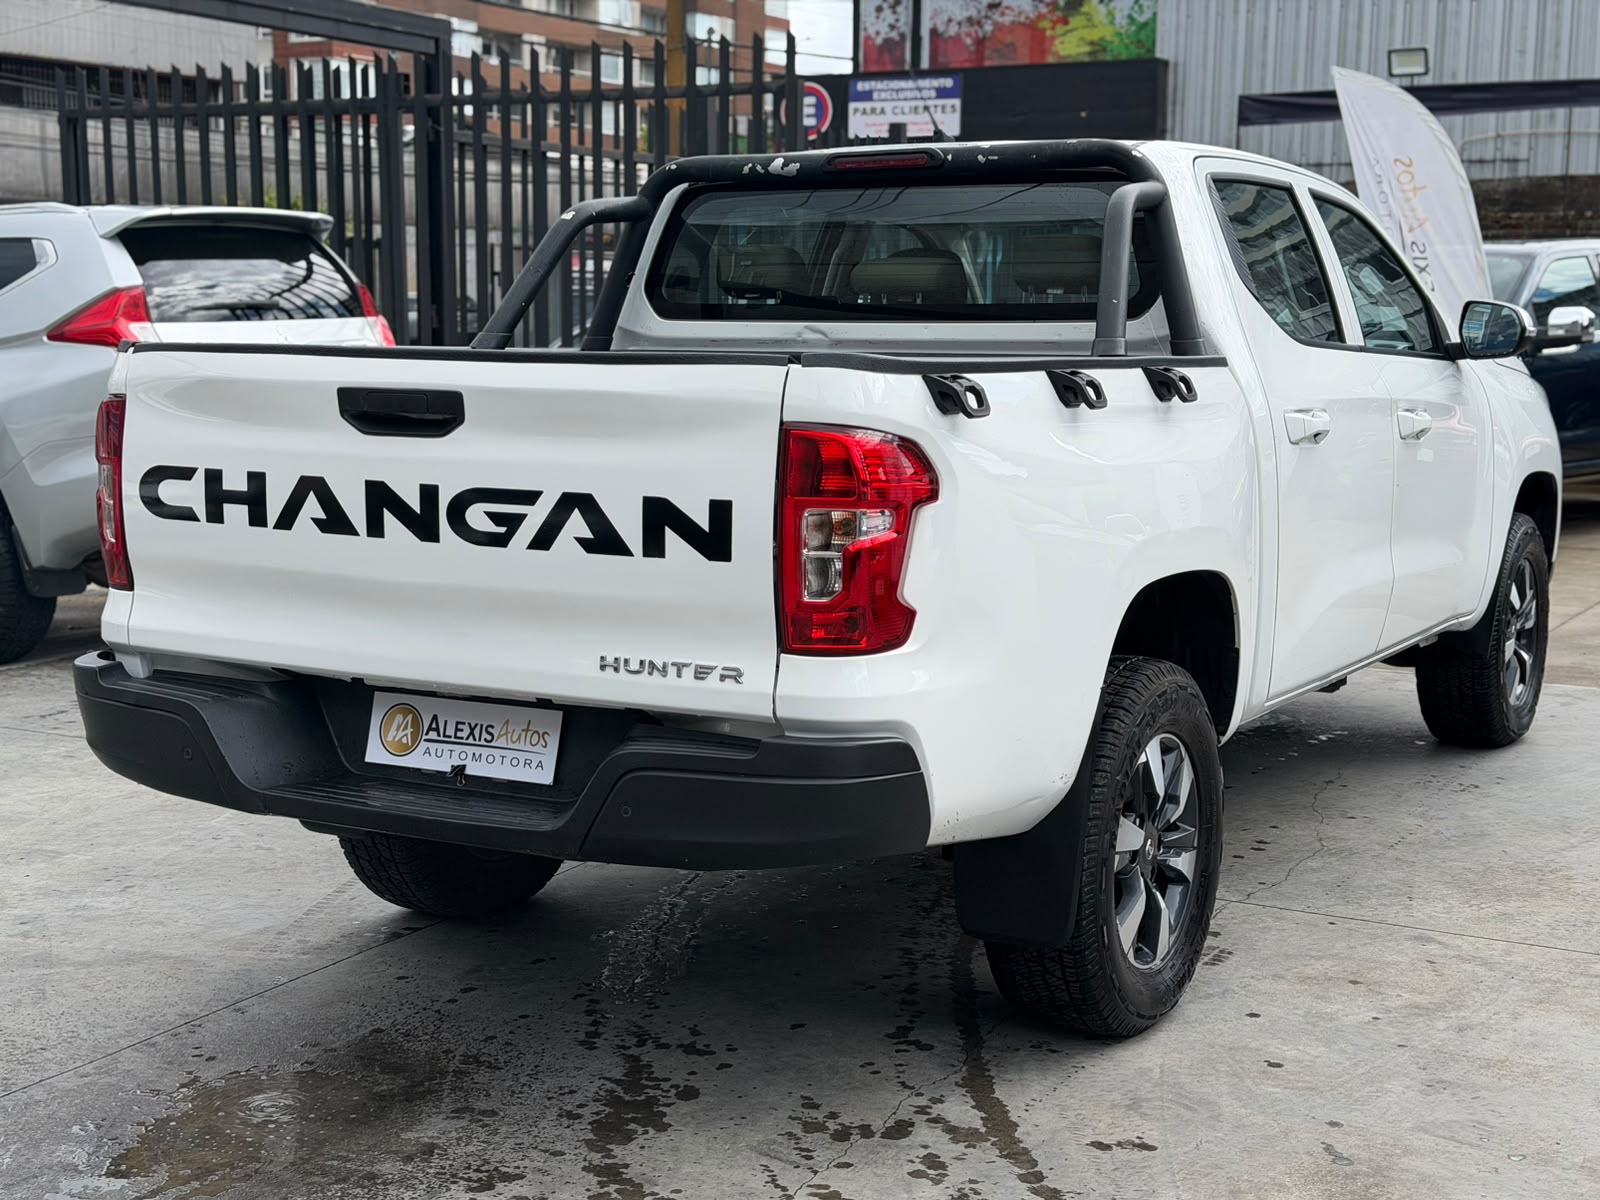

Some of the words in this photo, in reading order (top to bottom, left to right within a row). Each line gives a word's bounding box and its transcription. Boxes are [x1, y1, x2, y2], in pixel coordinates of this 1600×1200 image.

[852, 106, 887, 117] PARA
[891, 103, 957, 116] CLIENTES
[139, 464, 733, 563] CHANGAN
[599, 655, 745, 685] HUNTER
[422, 746, 544, 772] AUTOMOTORA
